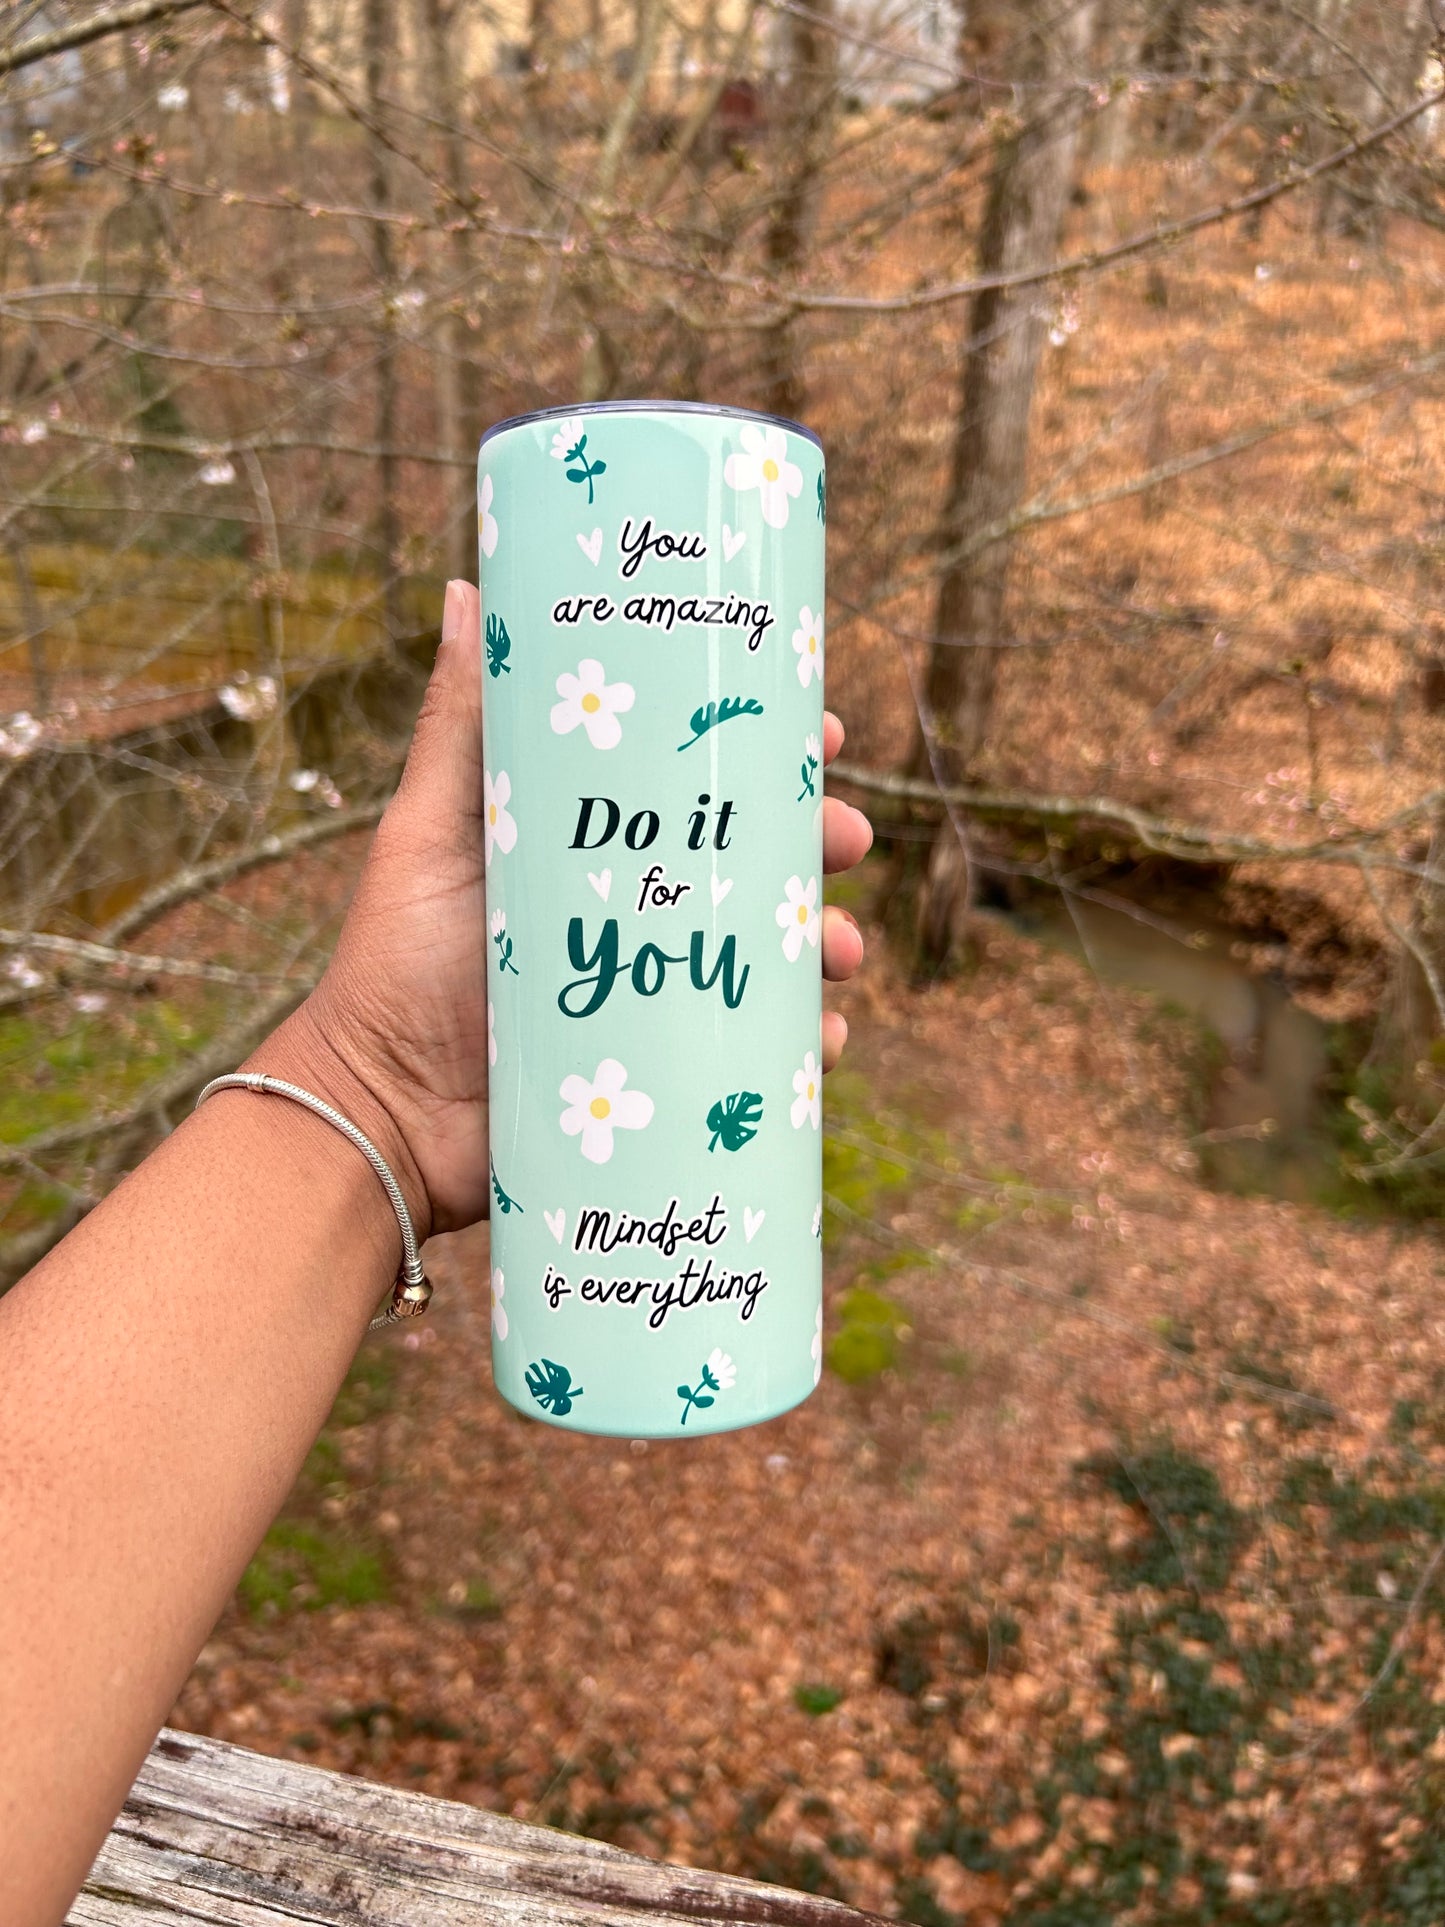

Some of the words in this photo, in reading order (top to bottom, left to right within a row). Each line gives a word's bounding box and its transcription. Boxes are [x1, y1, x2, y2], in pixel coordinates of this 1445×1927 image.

[620, 520, 707, 578] You
[553, 597, 615, 623] are
[623, 594, 774, 652] amazing
[567, 797, 661, 851] Do
[687, 793, 738, 851] it
[637, 865, 691, 912] for
[574, 1195, 727, 1257] Mindset
[544, 1266, 572, 1309] is
[580, 1258, 768, 1329] everything
